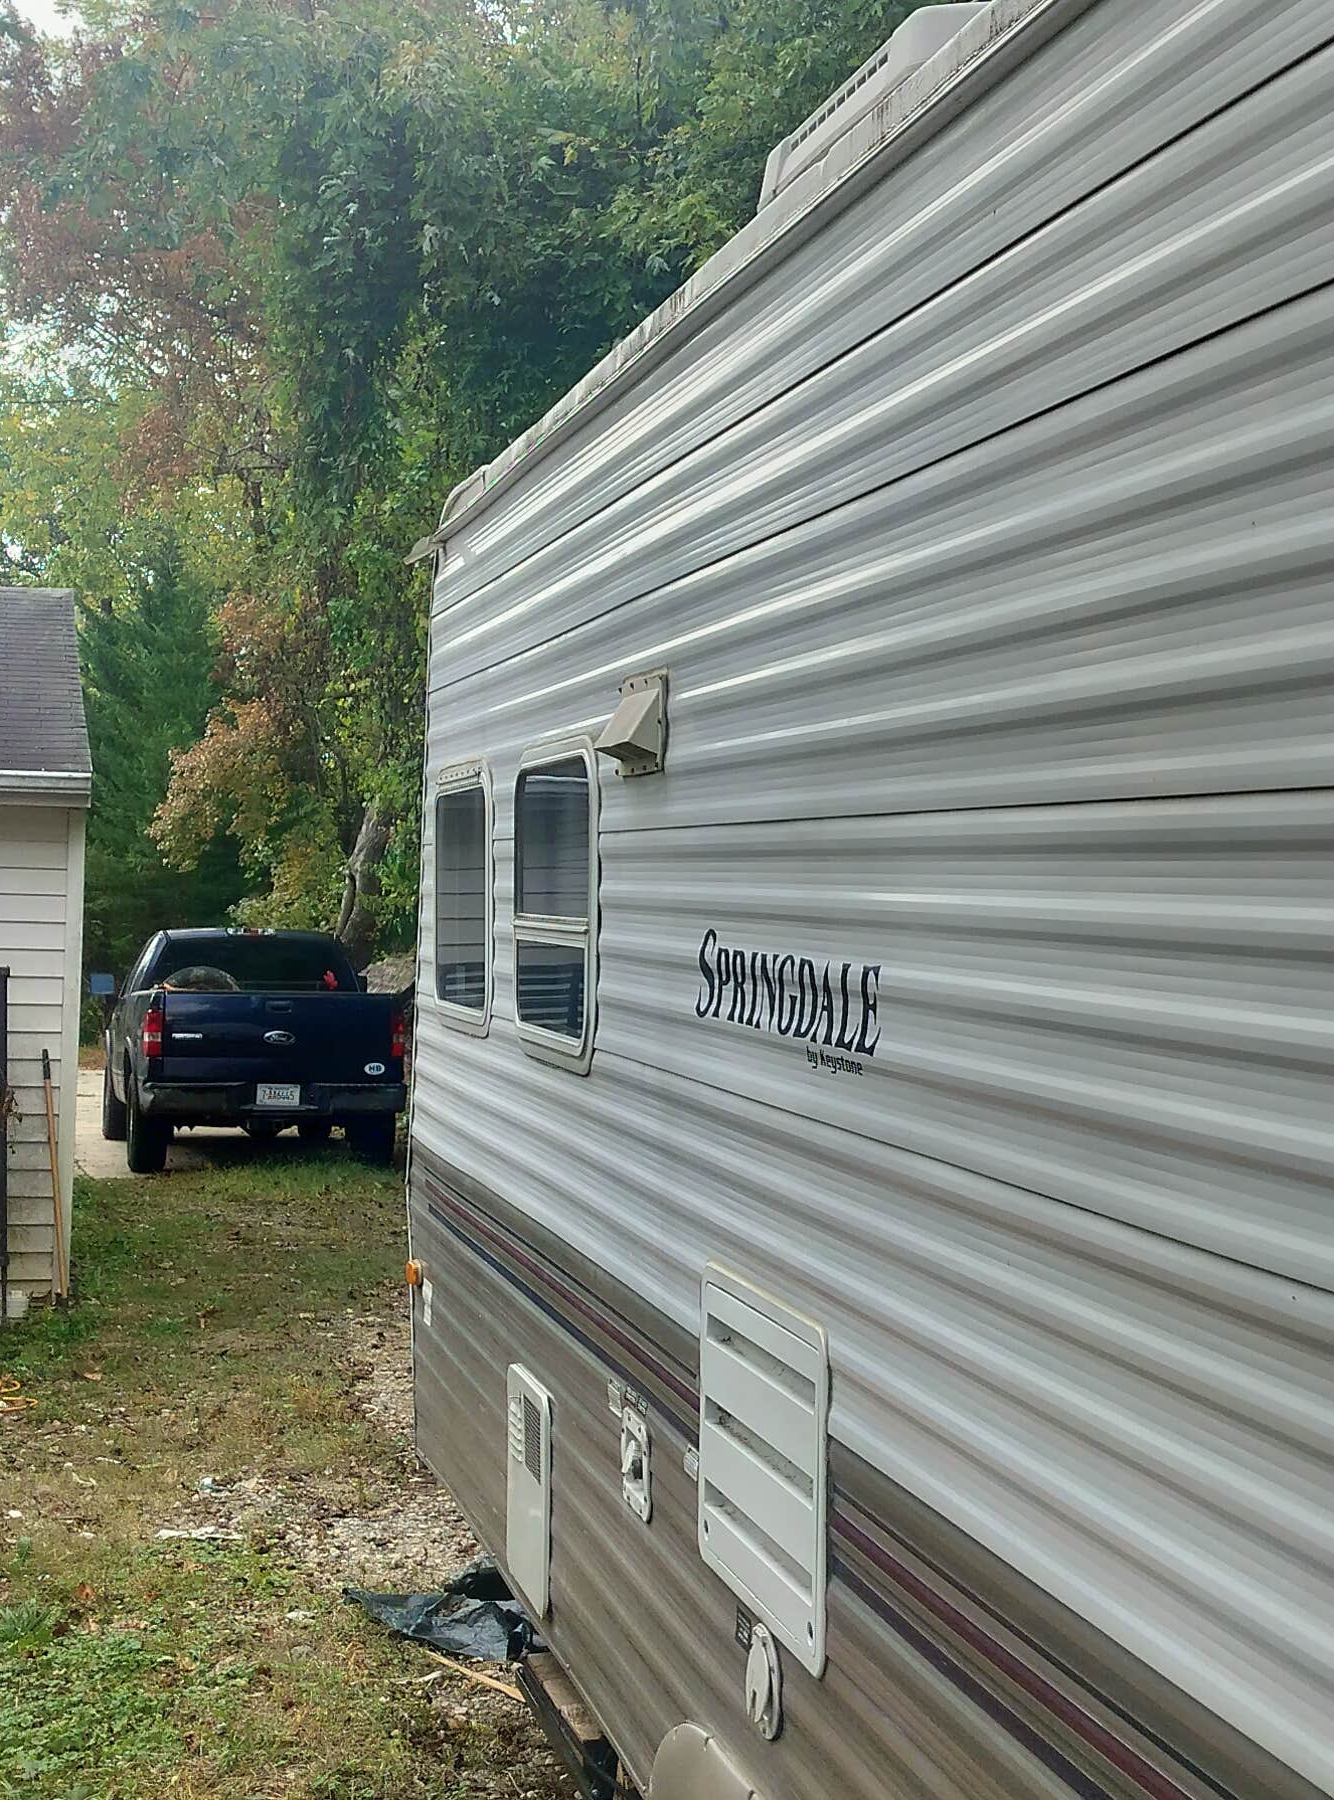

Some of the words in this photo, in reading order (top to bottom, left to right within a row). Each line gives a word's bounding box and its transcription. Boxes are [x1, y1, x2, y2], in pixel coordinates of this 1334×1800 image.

[695, 928, 882, 1056] SPRINGDALE
[806, 1045, 818, 1069] by
[820, 1049, 863, 1076] Keystone
